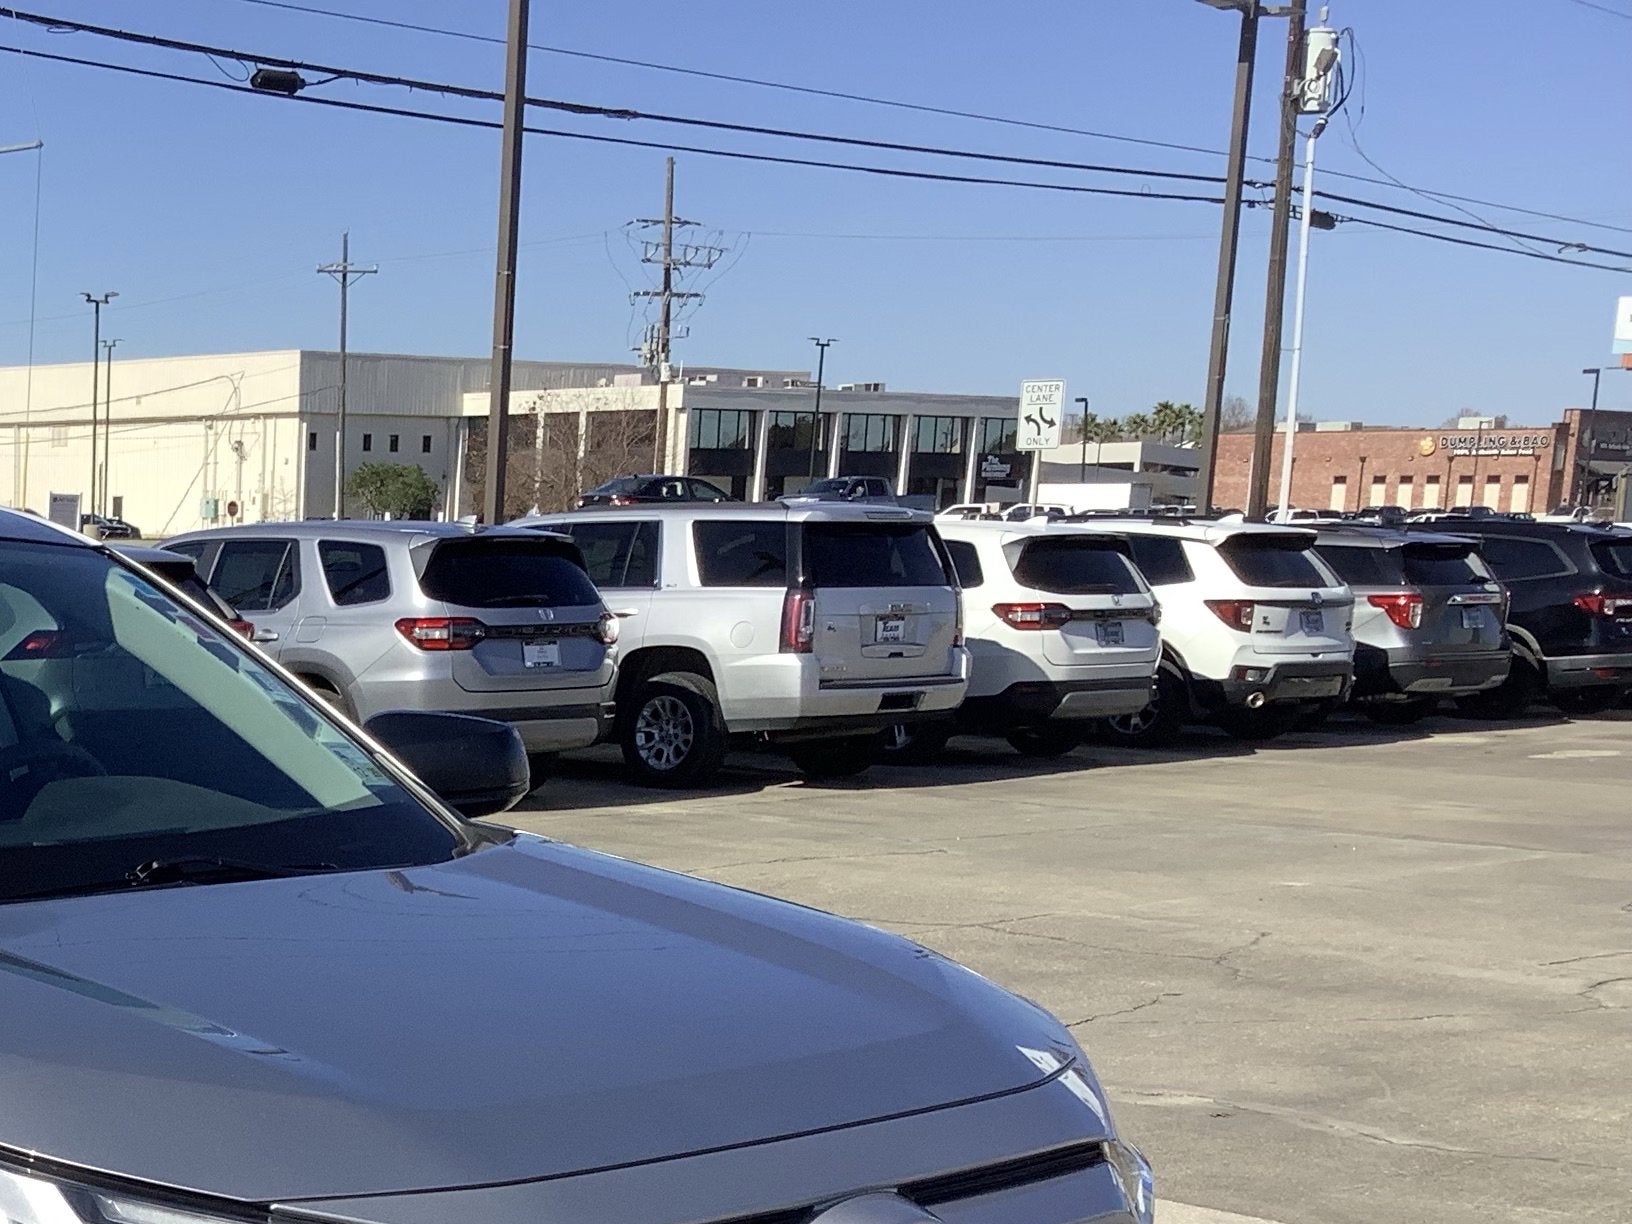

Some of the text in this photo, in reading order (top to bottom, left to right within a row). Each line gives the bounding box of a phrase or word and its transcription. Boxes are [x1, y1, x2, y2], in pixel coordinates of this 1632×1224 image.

[1025, 383, 1061, 394] CENTER
[1030, 393, 1055, 403] LANE
[1025, 437, 1051, 447] ONLY
[1440, 435, 1550, 449] DUMPLING & BAO
